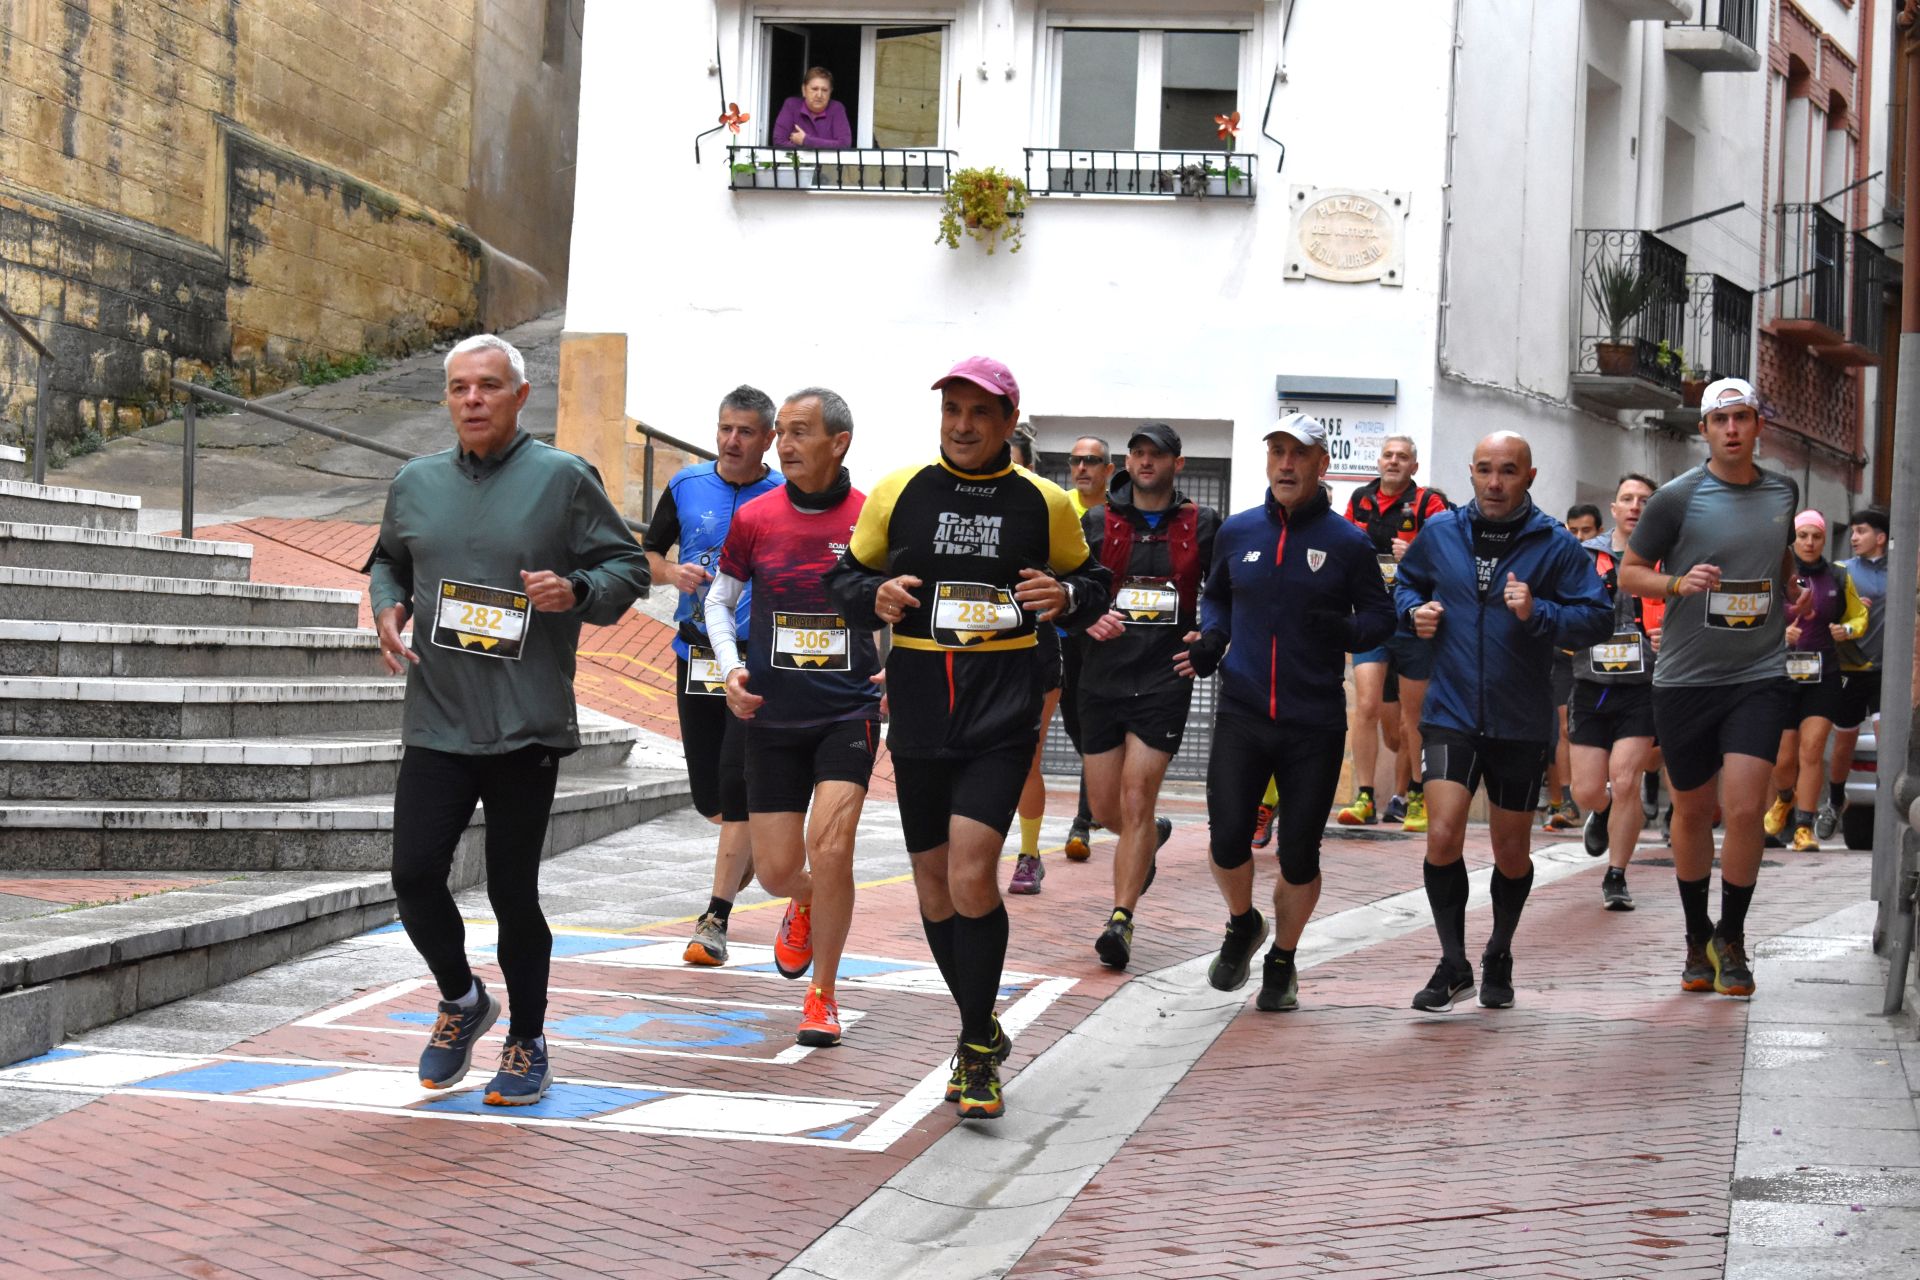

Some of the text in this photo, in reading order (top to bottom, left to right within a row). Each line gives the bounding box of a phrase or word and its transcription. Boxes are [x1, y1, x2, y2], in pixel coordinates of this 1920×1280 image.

[938, 512, 1003, 528] CxM
[933, 541, 1000, 558] TRAIL
[1130, 591, 1161, 606] 217
[1727, 595, 1758, 611] 261
[460, 604, 503, 630] 282
[958, 603, 999, 623] 283
[794, 631, 830, 648] 306
[1603, 646, 1627, 658] 212
